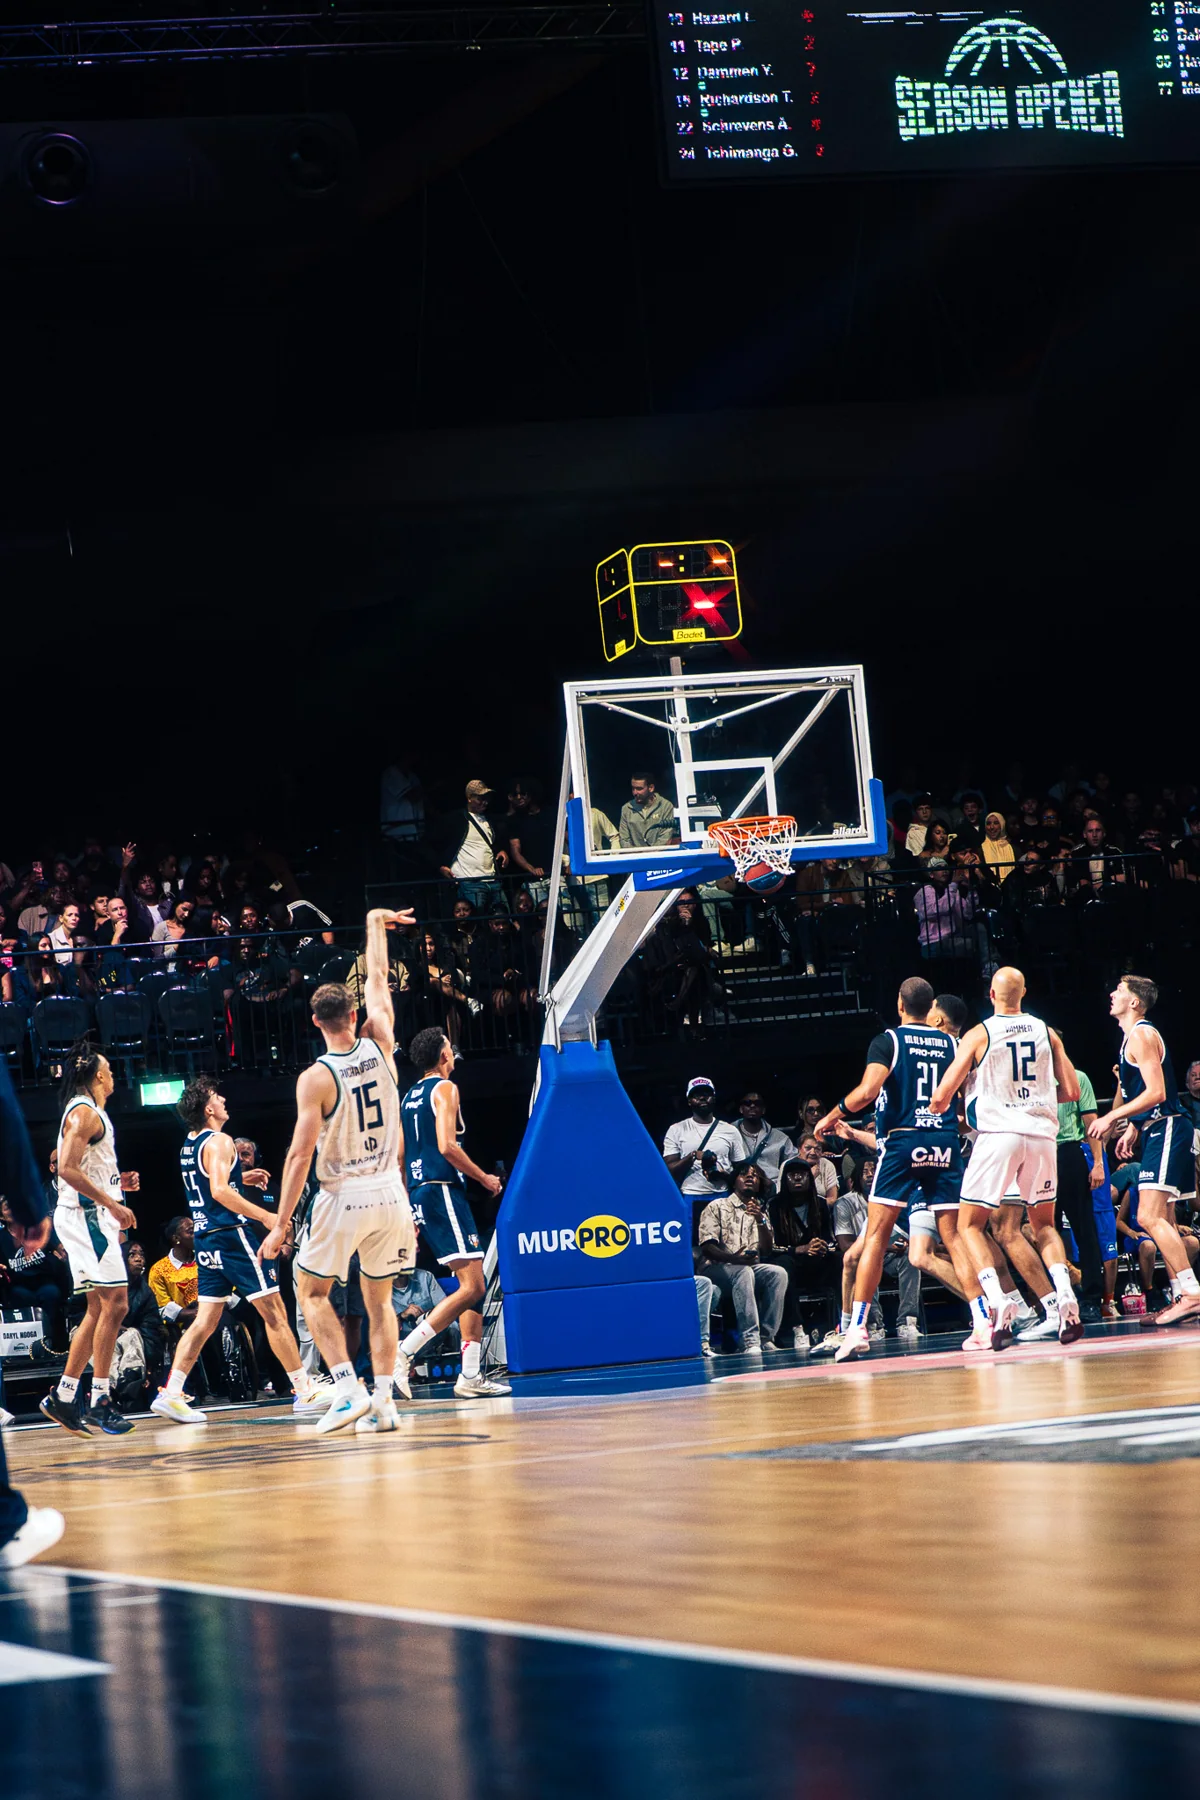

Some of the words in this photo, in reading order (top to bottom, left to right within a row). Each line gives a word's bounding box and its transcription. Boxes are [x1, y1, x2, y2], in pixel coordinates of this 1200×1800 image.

[672, 66, 689, 80] 12
[697, 66, 759, 80] Dammen
[700, 91, 779, 106] Richardson
[895, 75, 1009, 142] SEASON
[1014, 70, 1124, 139] OPENER
[1006, 1041, 1037, 1082] 12
[916, 1062, 938, 1101] 21
[352, 1080, 384, 1132] 15
[914, 1118, 943, 1129] KFC
[517, 1220, 683, 1255] MURPROTEC
